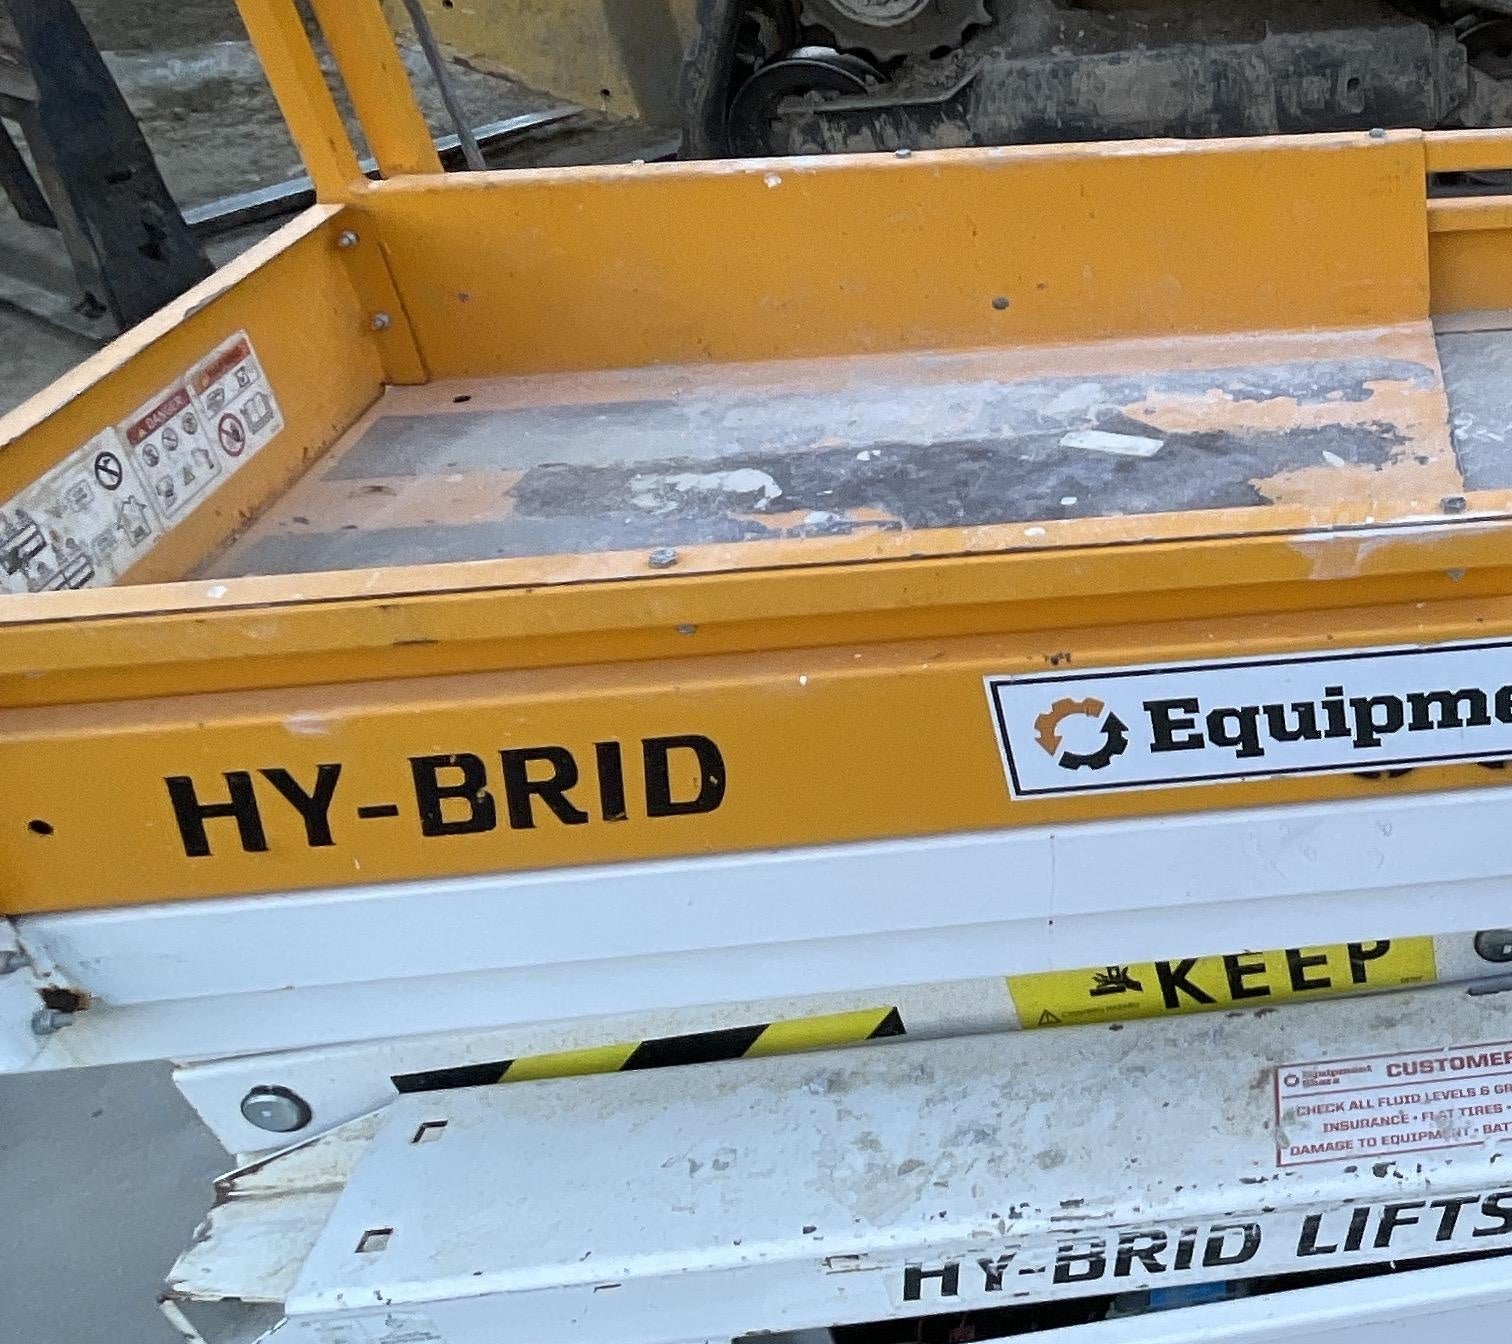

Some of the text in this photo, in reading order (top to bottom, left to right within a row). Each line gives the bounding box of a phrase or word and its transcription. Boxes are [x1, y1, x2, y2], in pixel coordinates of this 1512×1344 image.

[164, 734, 727, 857] HY-BRID
[1155, 939, 1391, 1009] KEEP
[1297, 1101, 1344, 1116] CHECK
[1350, 1098, 1373, 1111] ALL
[1378, 1093, 1420, 1106] FLUID
[1425, 1088, 1476, 1102] LEVELS
[1323, 1114, 1409, 1132] INSURANCE
[1461, 1103, 1503, 1117] TIRES
[1290, 1139, 1353, 1156] DAMAGE
[1359, 1137, 1377, 1147] TO
[902, 1221, 1262, 1302] HY-BRID
